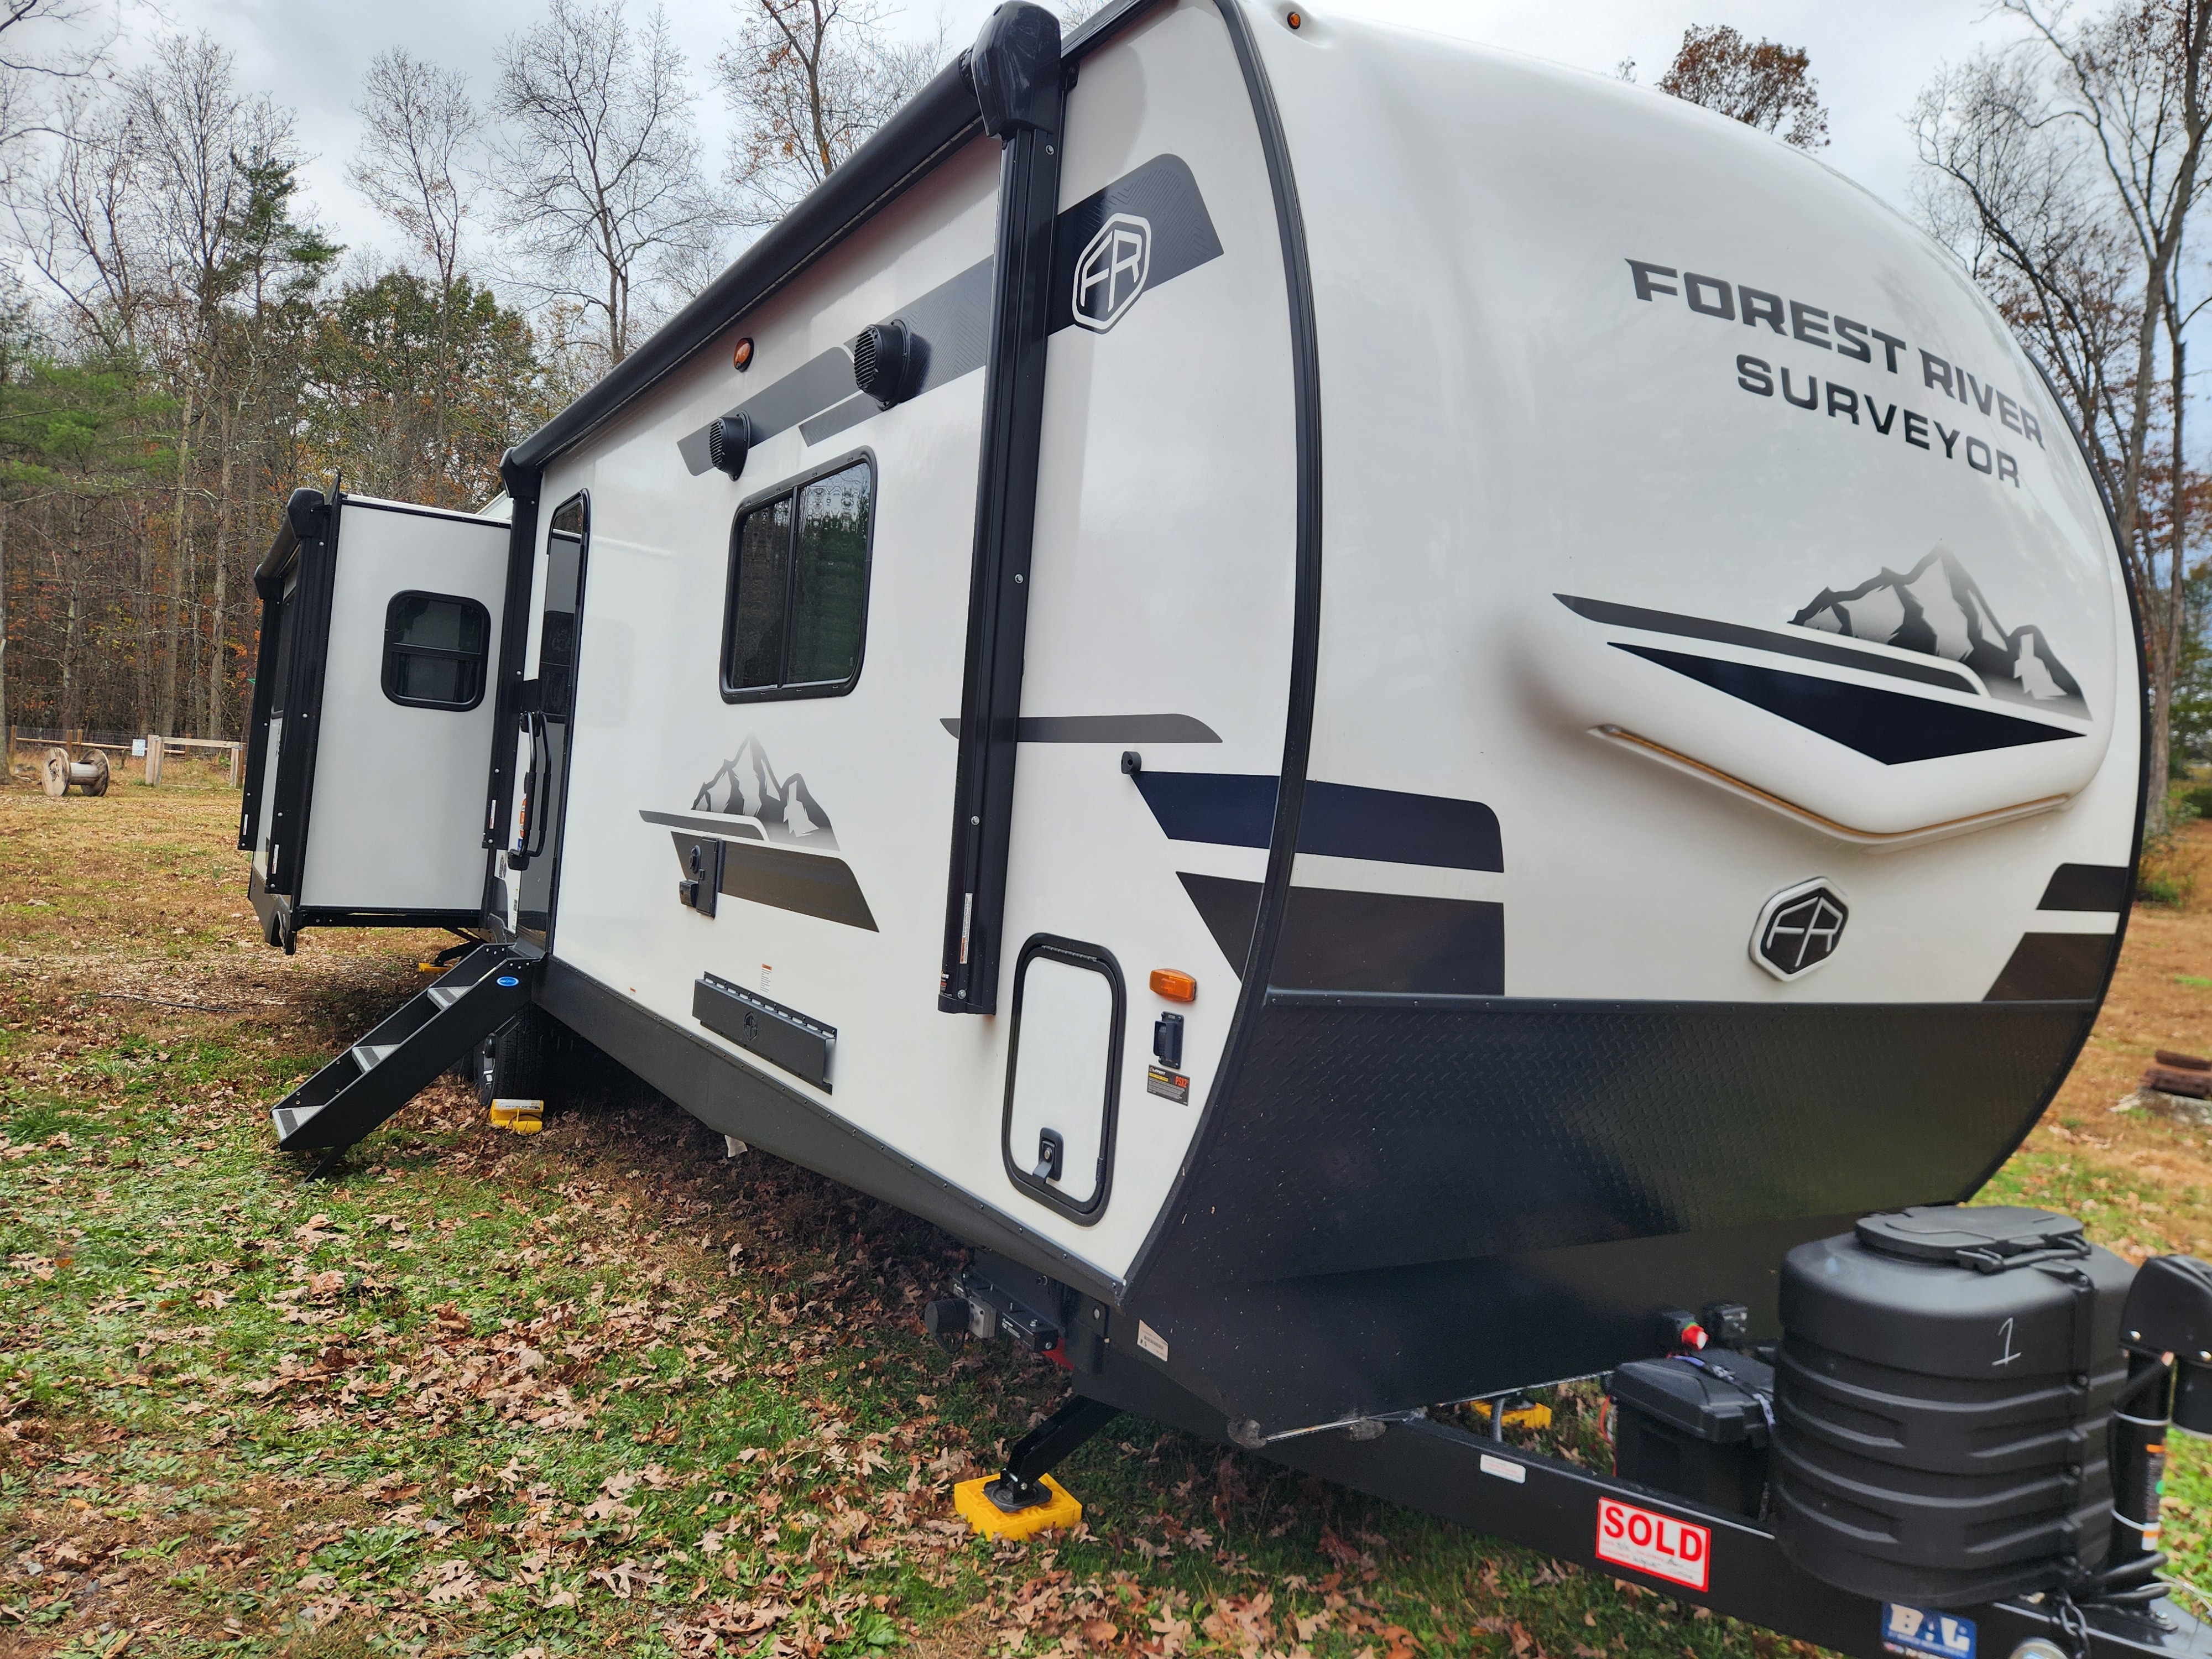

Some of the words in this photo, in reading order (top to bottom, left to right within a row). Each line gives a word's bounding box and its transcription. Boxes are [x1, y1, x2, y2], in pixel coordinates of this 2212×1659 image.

[1624, 258, 1906, 374] FOREST
[1918, 347, 2046, 451] RIVER
[1736, 354, 2020, 488] SURVEYOR
[1604, 1506, 1702, 1562] SOLD
